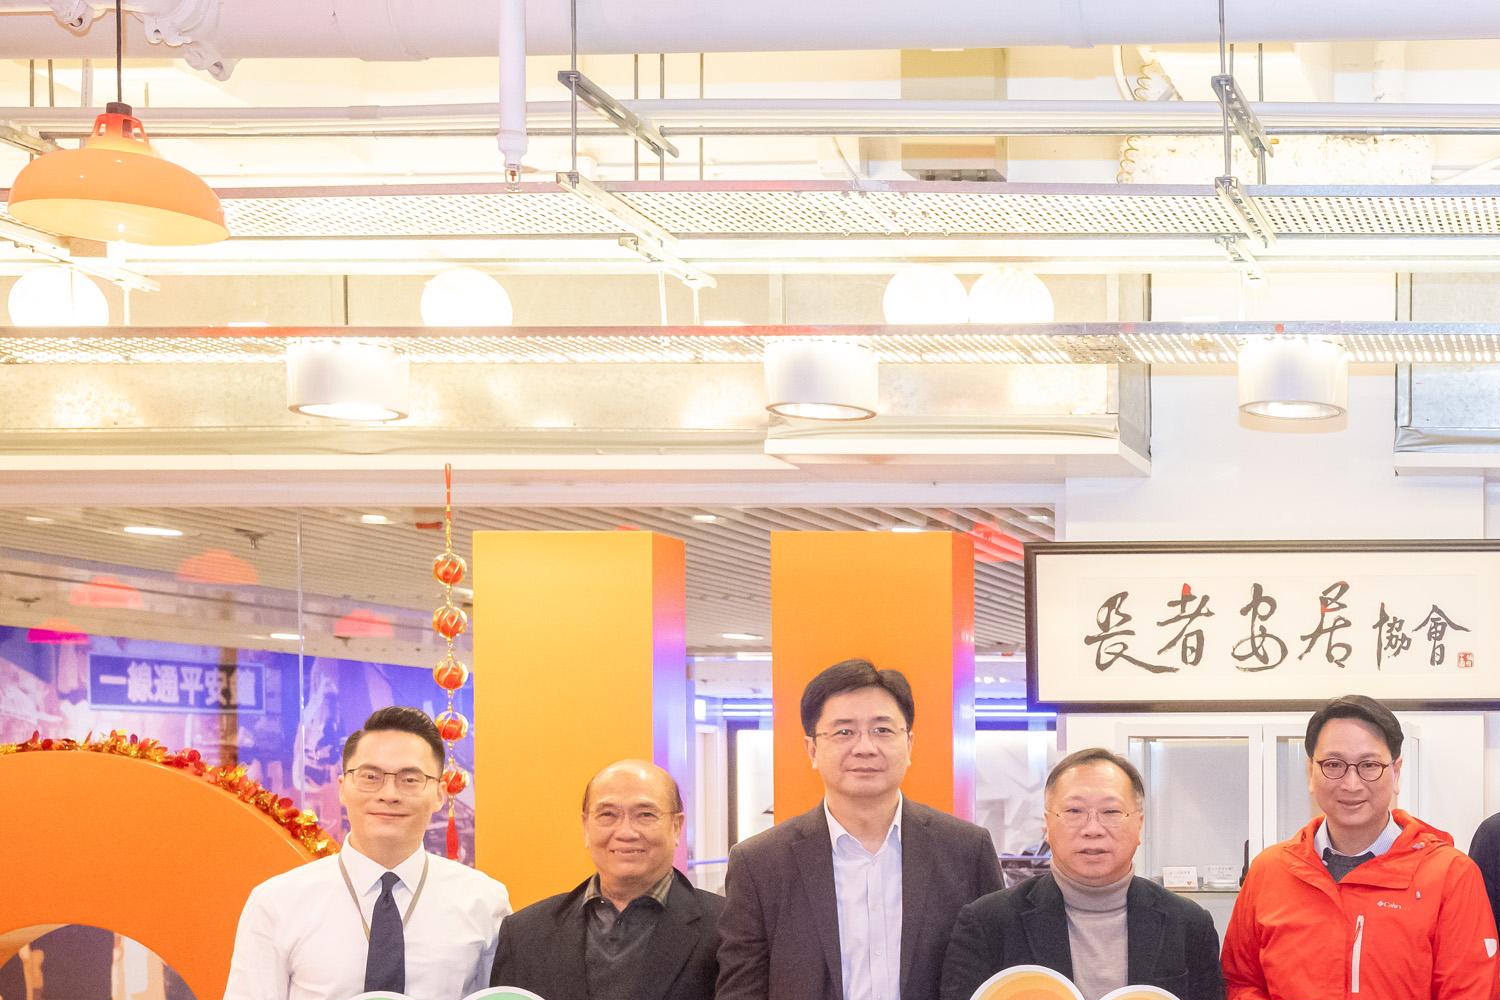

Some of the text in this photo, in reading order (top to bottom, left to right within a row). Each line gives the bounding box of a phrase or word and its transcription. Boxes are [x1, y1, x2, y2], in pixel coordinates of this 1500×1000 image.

[1083, 581, 1472, 673] 長者安居協會
